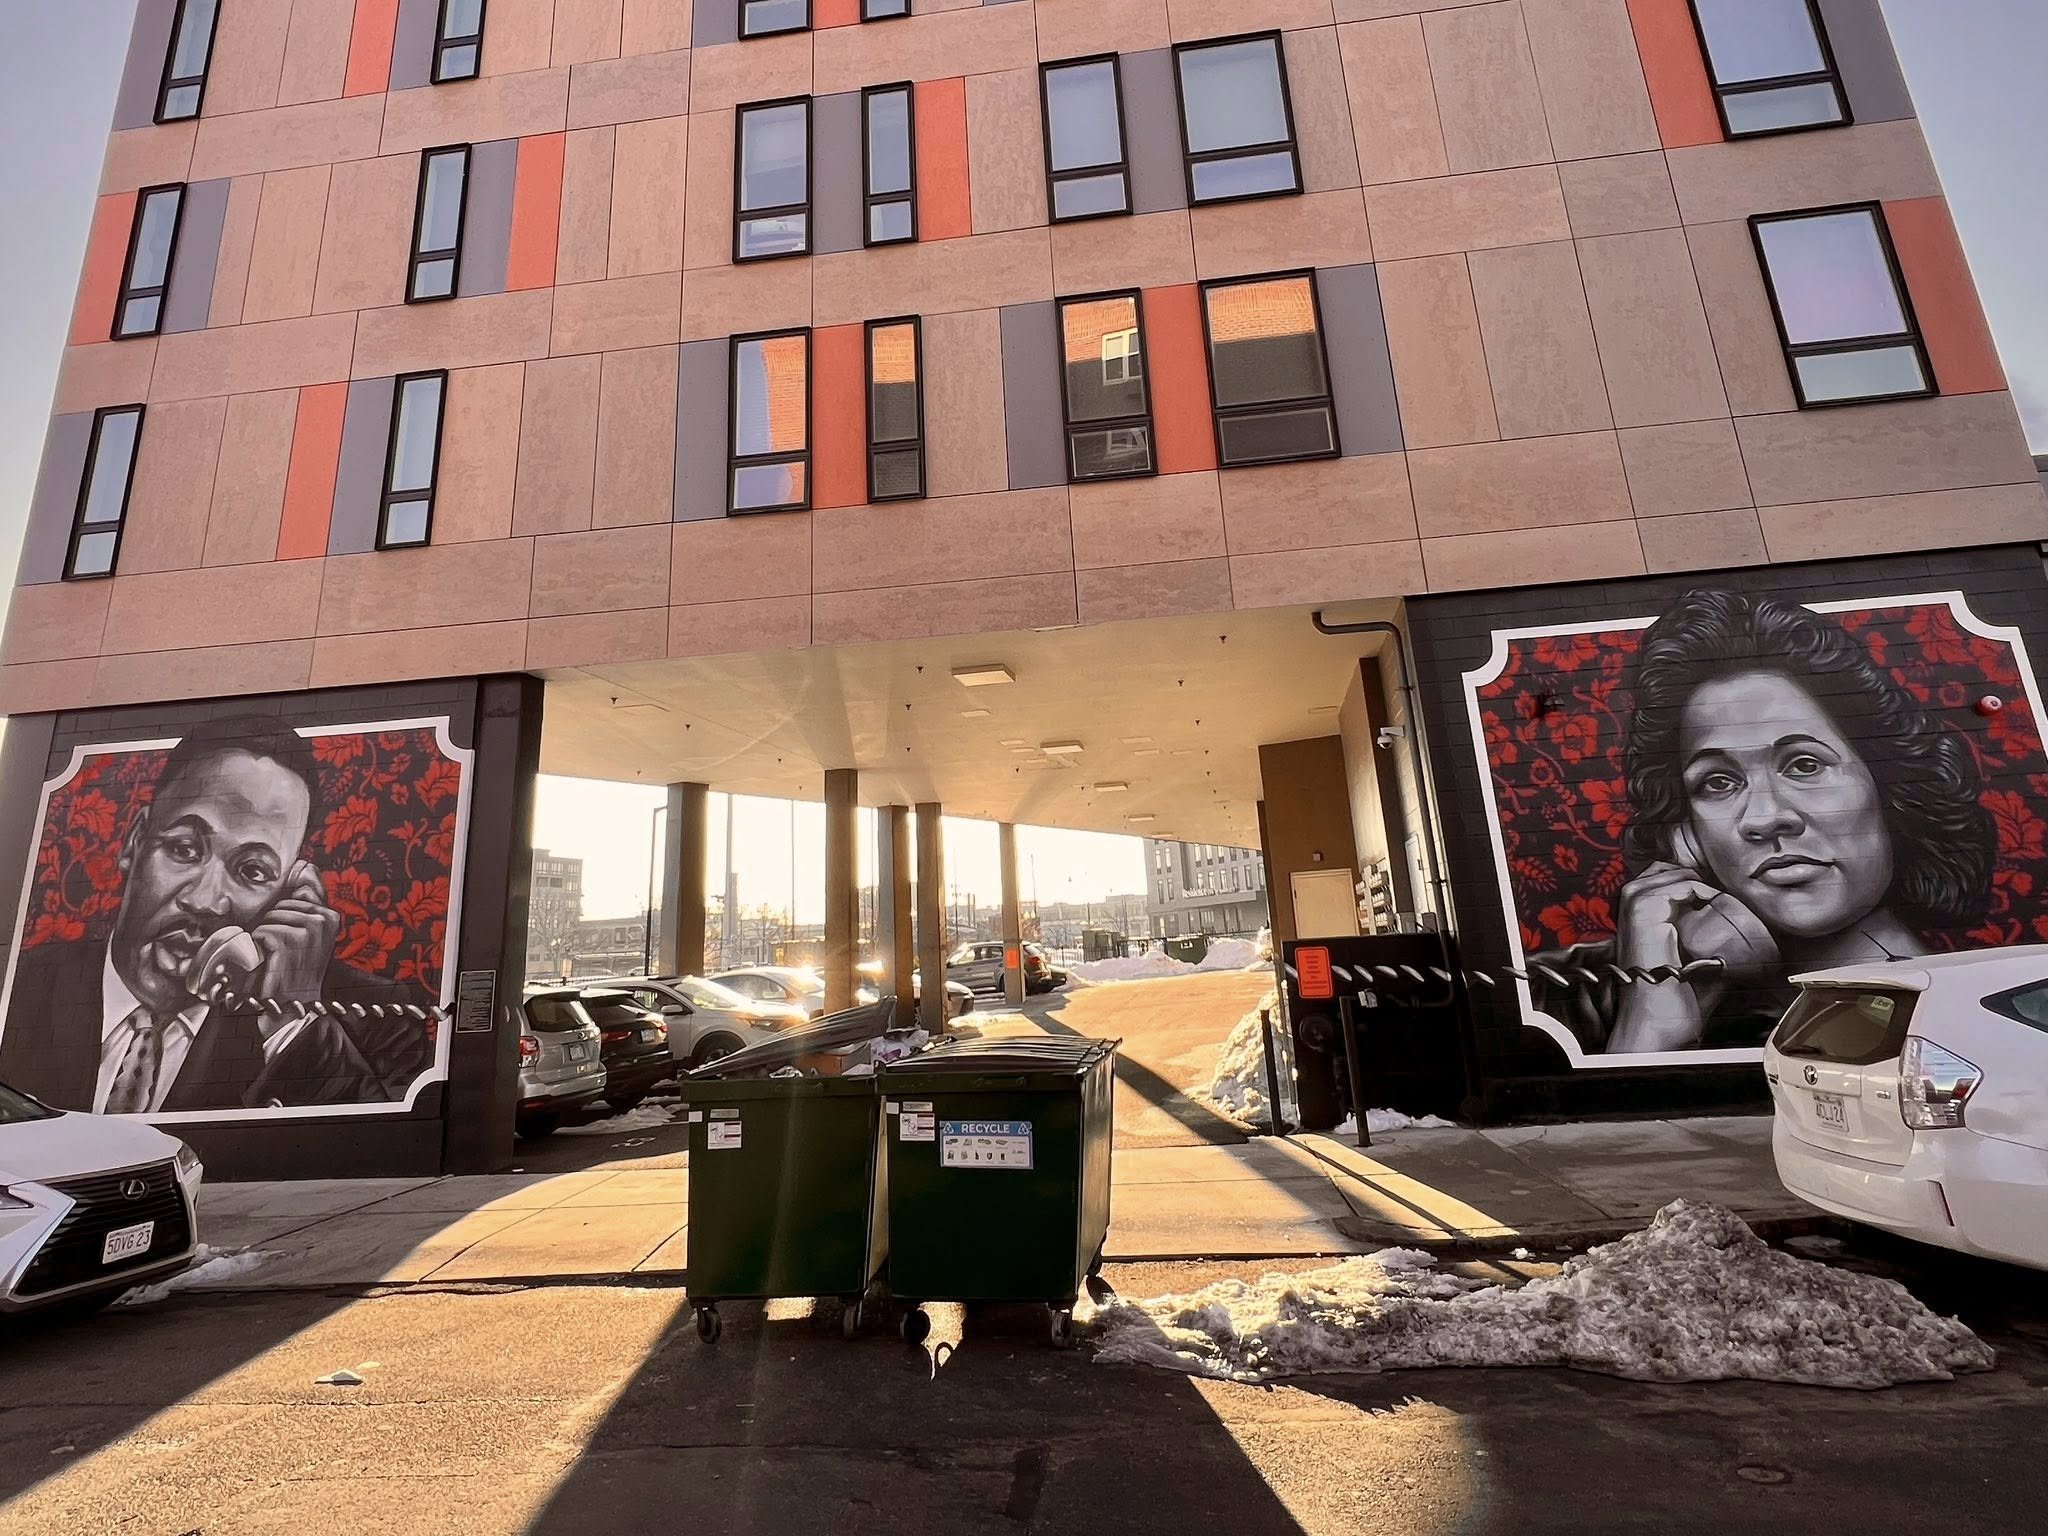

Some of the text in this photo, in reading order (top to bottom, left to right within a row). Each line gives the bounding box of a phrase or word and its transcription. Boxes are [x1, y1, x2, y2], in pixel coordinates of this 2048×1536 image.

[961, 1123, 1010, 1134] RECYCLE
[107, 1229, 151, 1255] 5DVG 23
